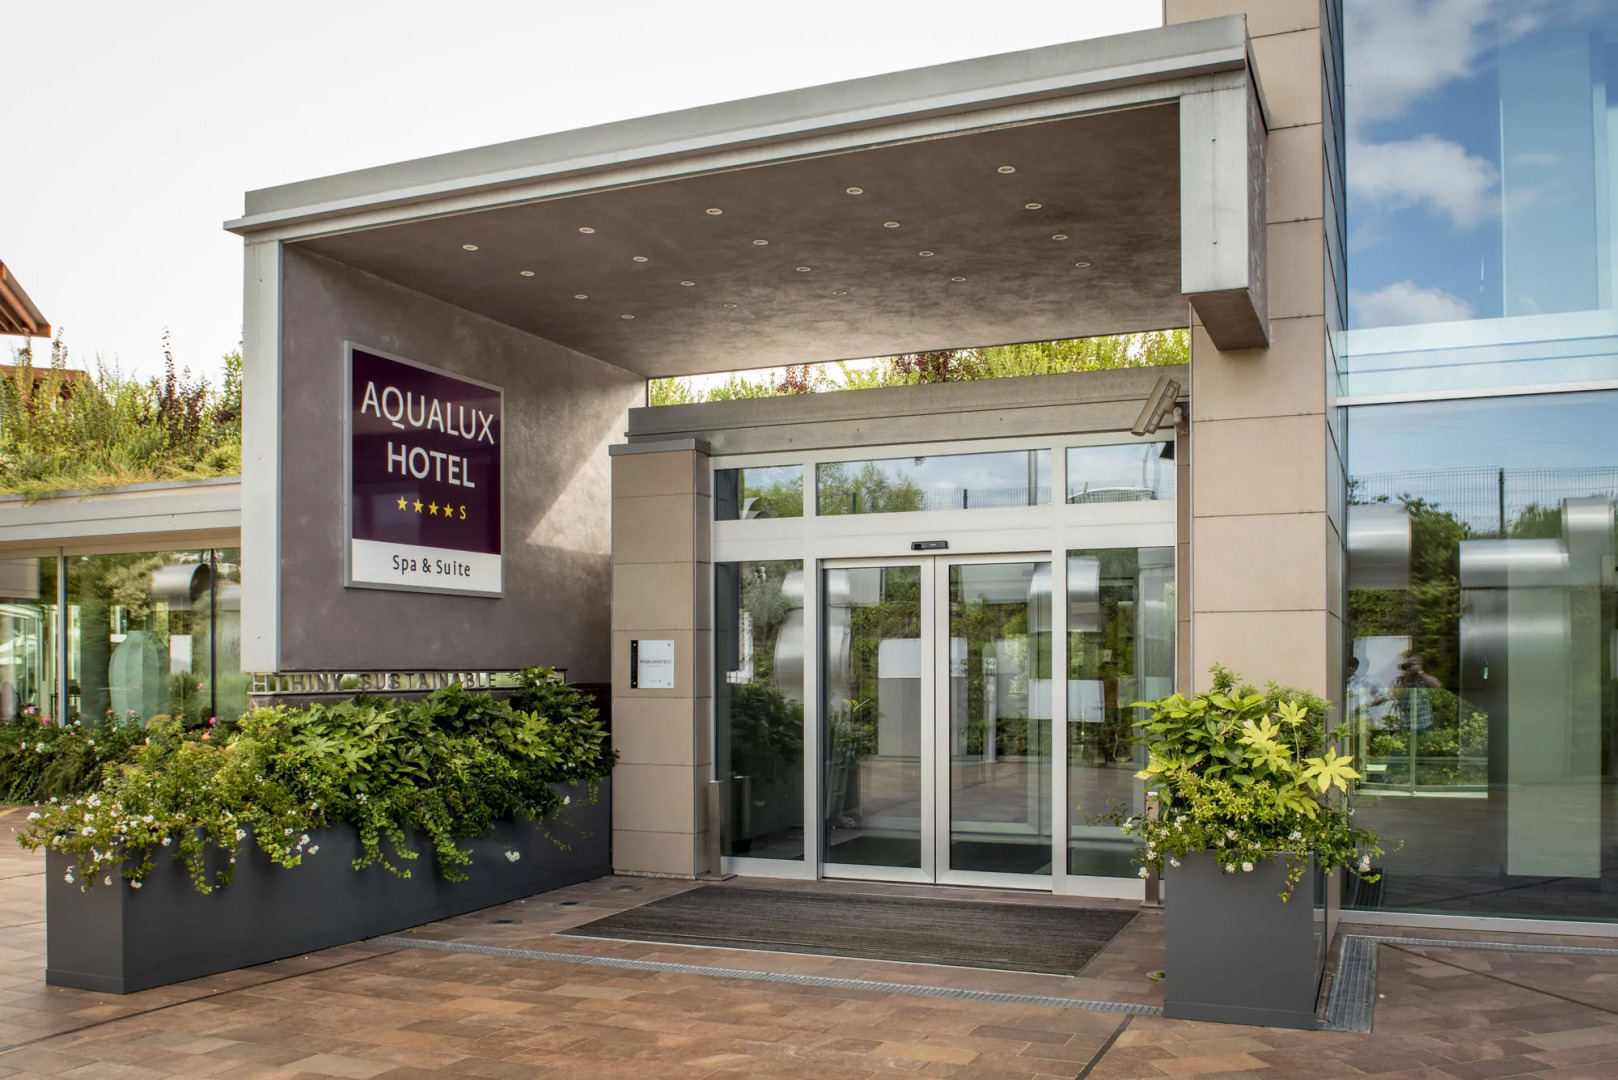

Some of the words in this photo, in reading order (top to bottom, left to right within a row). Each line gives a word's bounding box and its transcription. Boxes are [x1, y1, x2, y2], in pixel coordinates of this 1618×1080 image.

[360, 381, 495, 444] AQUALUX
[387, 441, 476, 488] HOTEL
[392, 555, 417, 575] Spa
[422, 559, 431, 573] &
[436, 560, 471, 577] Suite
[358, 672, 496, 690] SUSTAINABLE
